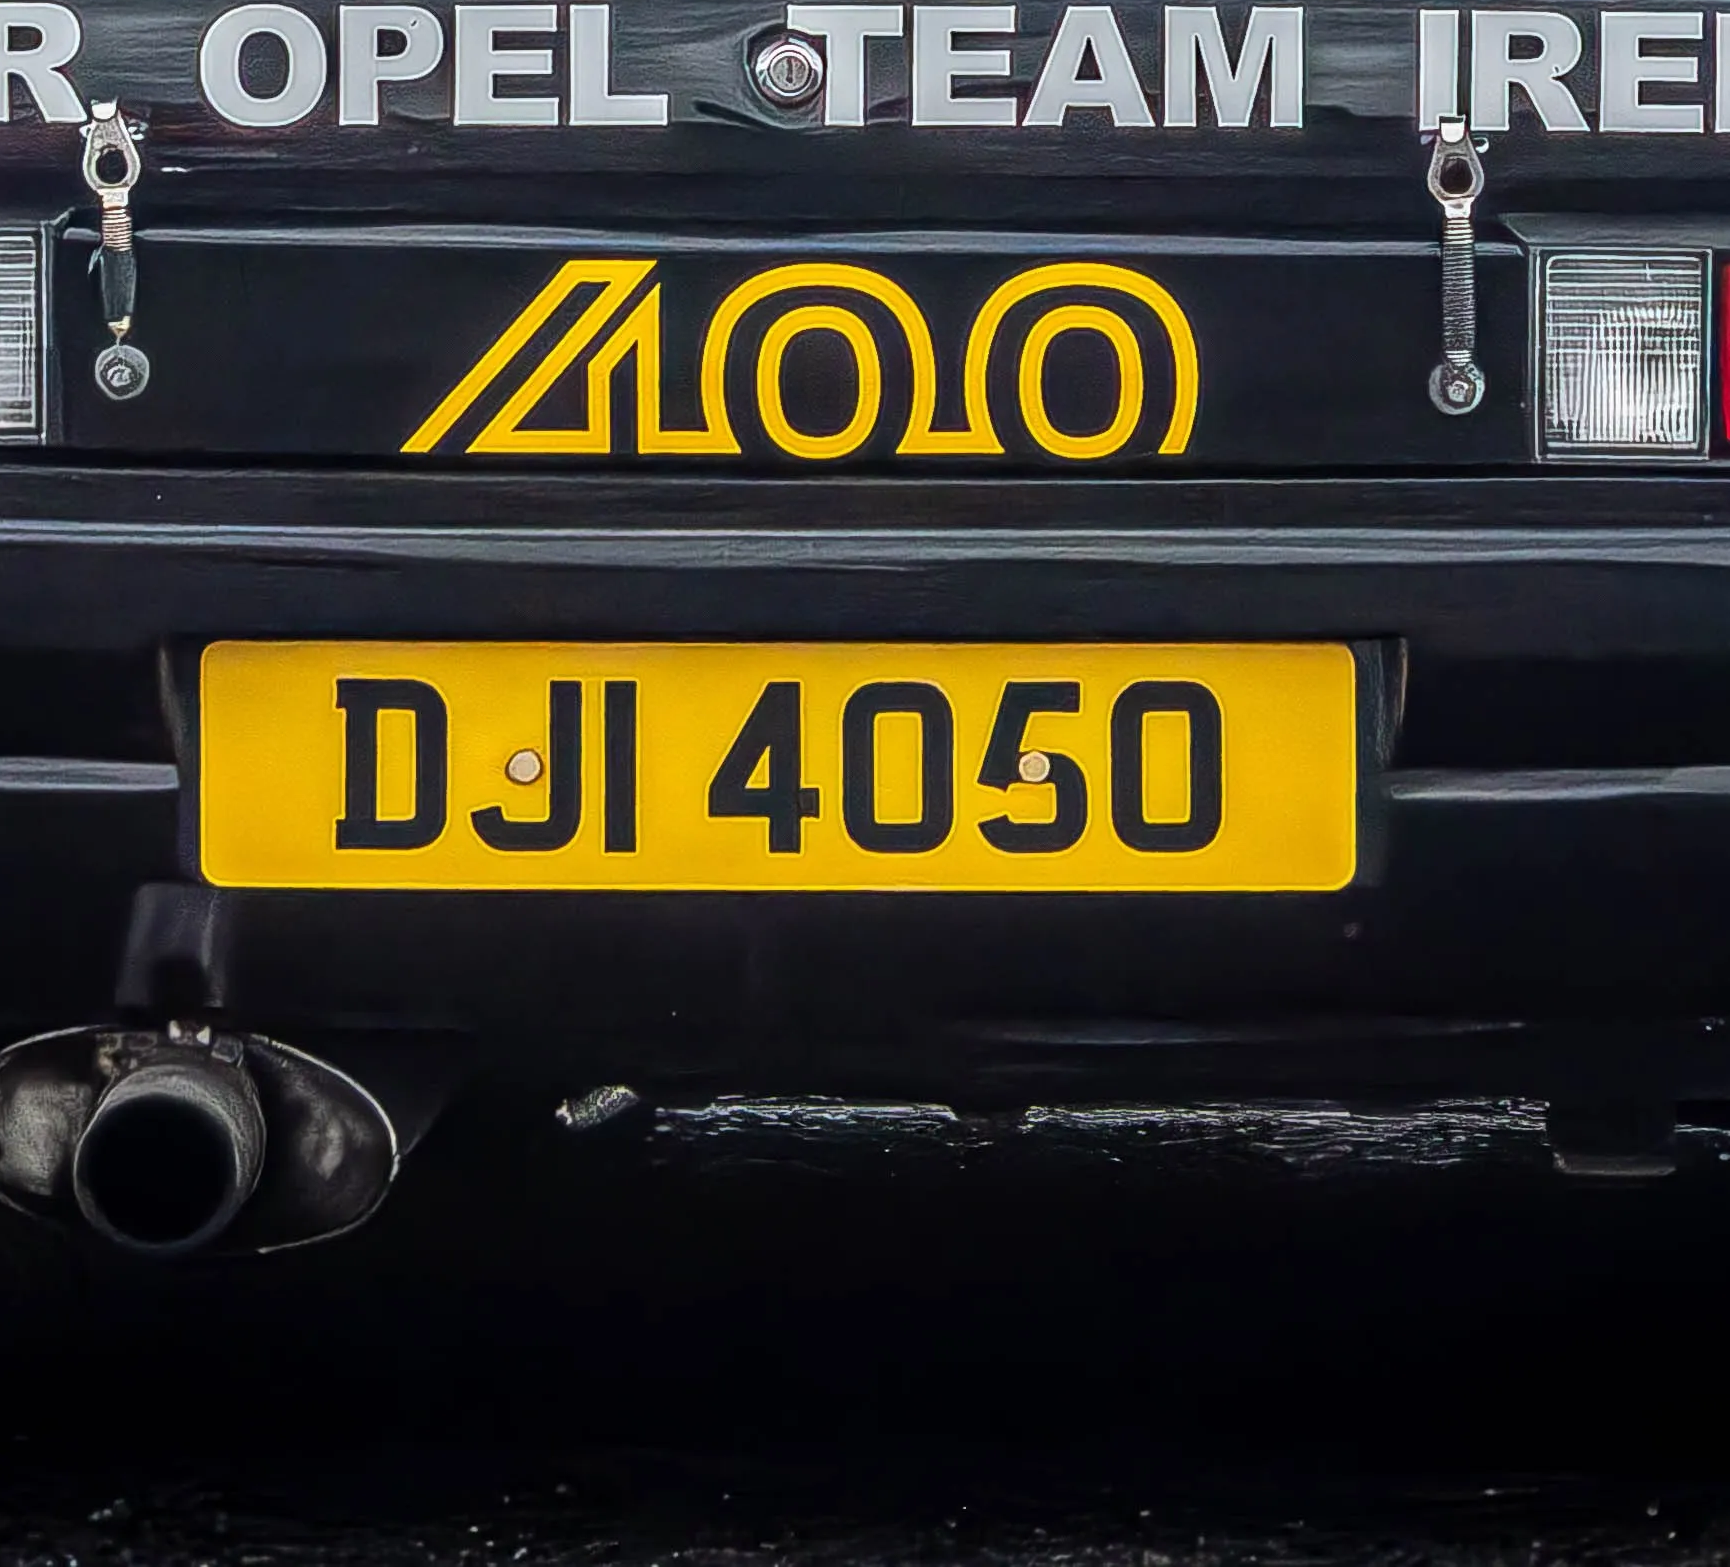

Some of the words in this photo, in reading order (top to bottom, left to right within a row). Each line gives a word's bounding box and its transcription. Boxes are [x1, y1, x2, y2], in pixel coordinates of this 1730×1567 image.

[199, 2, 670, 128] OPEL
[785, 3, 1305, 130] TEAM
[400, 259, 1200, 460] 400
[334, 678, 638, 853] DJI
[707, 680, 1224, 853] 4050
